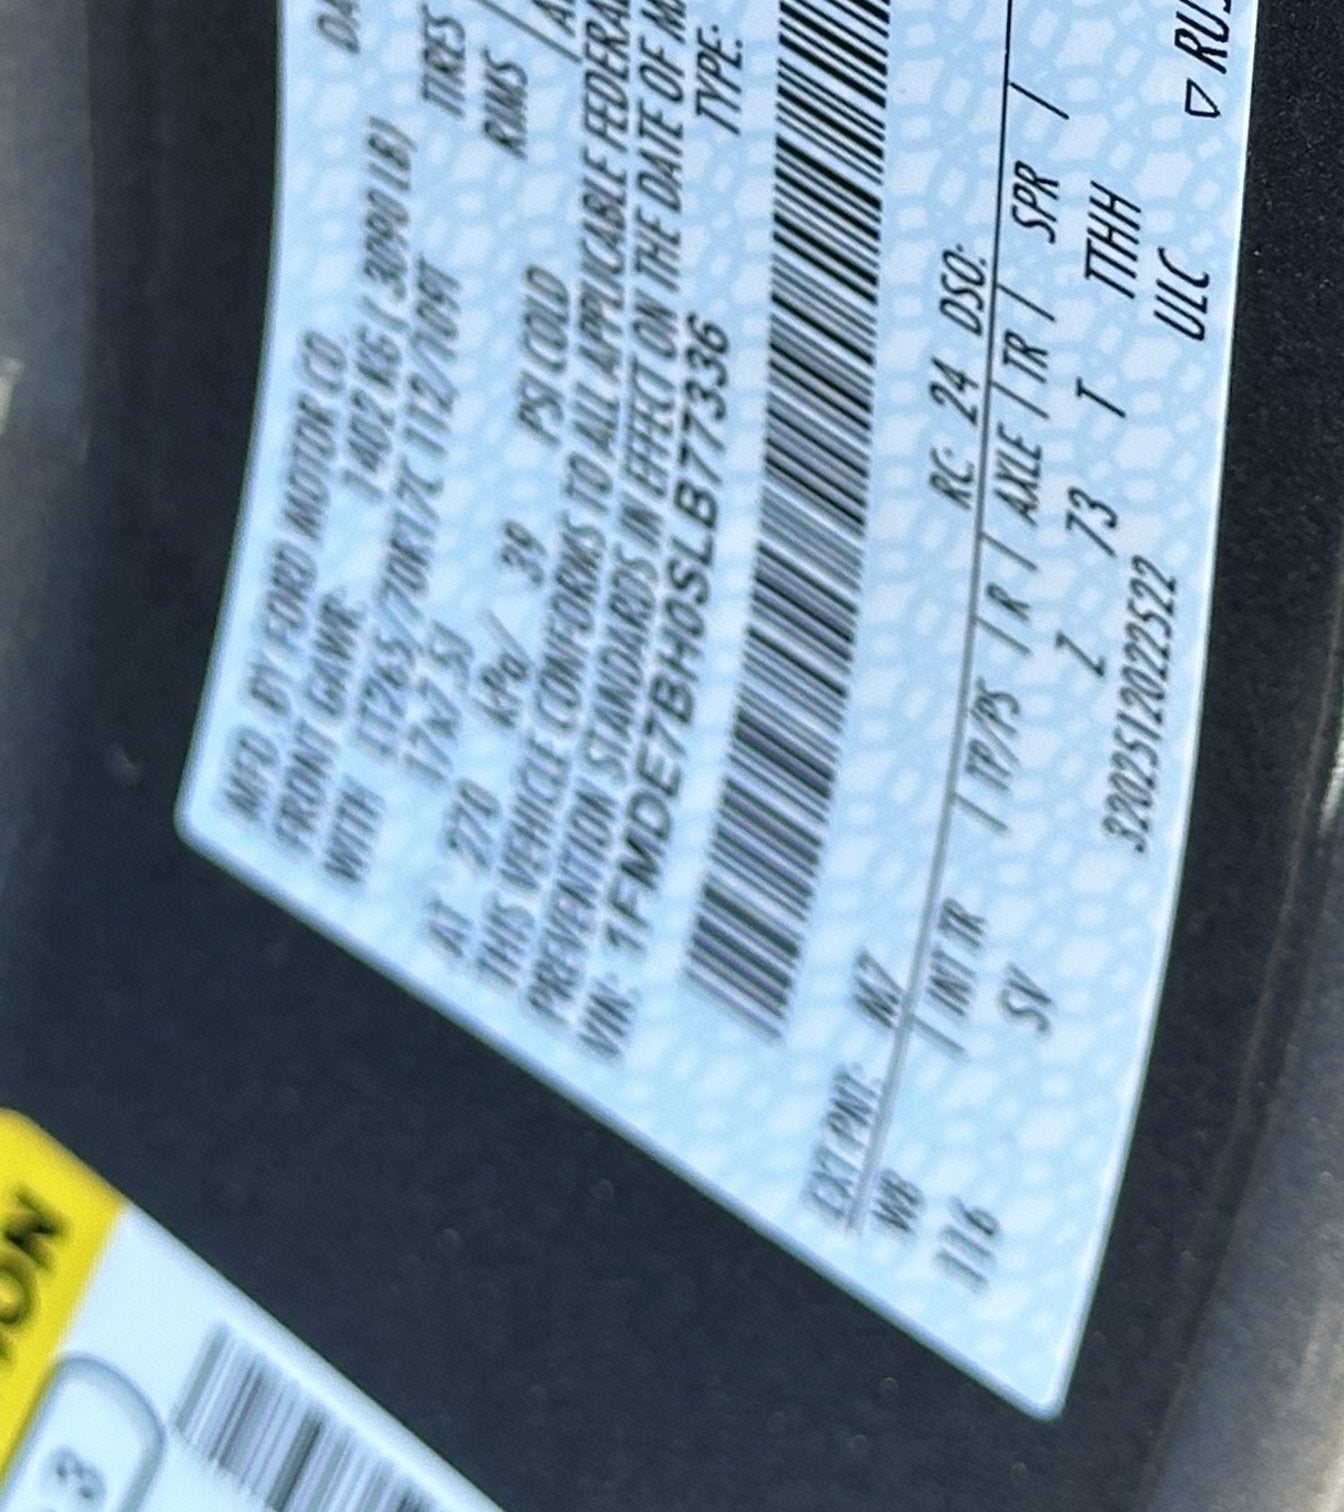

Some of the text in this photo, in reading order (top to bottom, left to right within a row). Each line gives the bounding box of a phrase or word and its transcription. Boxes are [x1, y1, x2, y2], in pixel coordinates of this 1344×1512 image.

[419, 2, 467, 118] TIRES
[478, 45, 530, 159] RIMS
[638, 32, 685, 106] OF
[694, 22, 744, 135] TYPE:
[637, 98, 685, 213] DATE
[1010, 159, 1060, 245] SPR
[361, 189, 410, 298] 3090
[574, 145, 629, 383] APPLICABLE
[632, 203, 683, 295] THE
[1083, 178, 1142, 299] TTHH
[1152, 244, 1210, 341] ULC
[353, 322, 403, 393] KG
[521, 262, 571, 373] COLD
[632, 285, 680, 359] ON
[1000, 326, 1050, 384] TR
[511, 368, 565, 451] PSI
[570, 379, 622, 459] ALL
[621, 360, 676, 498] EFFECT
[928, 241, 987, 510] RC: 24 DSO:
[1074, 375, 1127, 418] T
[280, 393, 339, 541] MOTOR
[341, 388, 396, 500] 1402
[562, 449, 611, 514] TO
[991, 418, 1043, 526] AXLE
[323, 254, 462, 886] WITH LT265/70R17C 112/109T
[498, 518, 546, 586] 39
[616, 486, 663, 552] IN
[1065, 484, 1119, 558] 73
[257, 542, 317, 651] FORD
[531, 510, 606, 737] CONFORMS
[985, 582, 1031, 621] R
[578, 538, 660, 784] STANDARDS
[1099, 552, 1180, 854] 3202512022522
[274, 718, 336, 857] FRONT
[963, 675, 1020, 794] TP/PS
[444, 776, 501, 870] 270
[496, 734, 570, 896] VEHICLE
[425, 892, 474, 964] AT
[475, 891, 537, 992] THIS
[526, 776, 618, 1031] PREVENTION
[924, 895, 988, 1019] INT TR
[995, 960, 1055, 1036] SV
[930, 1195, 1003, 1291] 116
